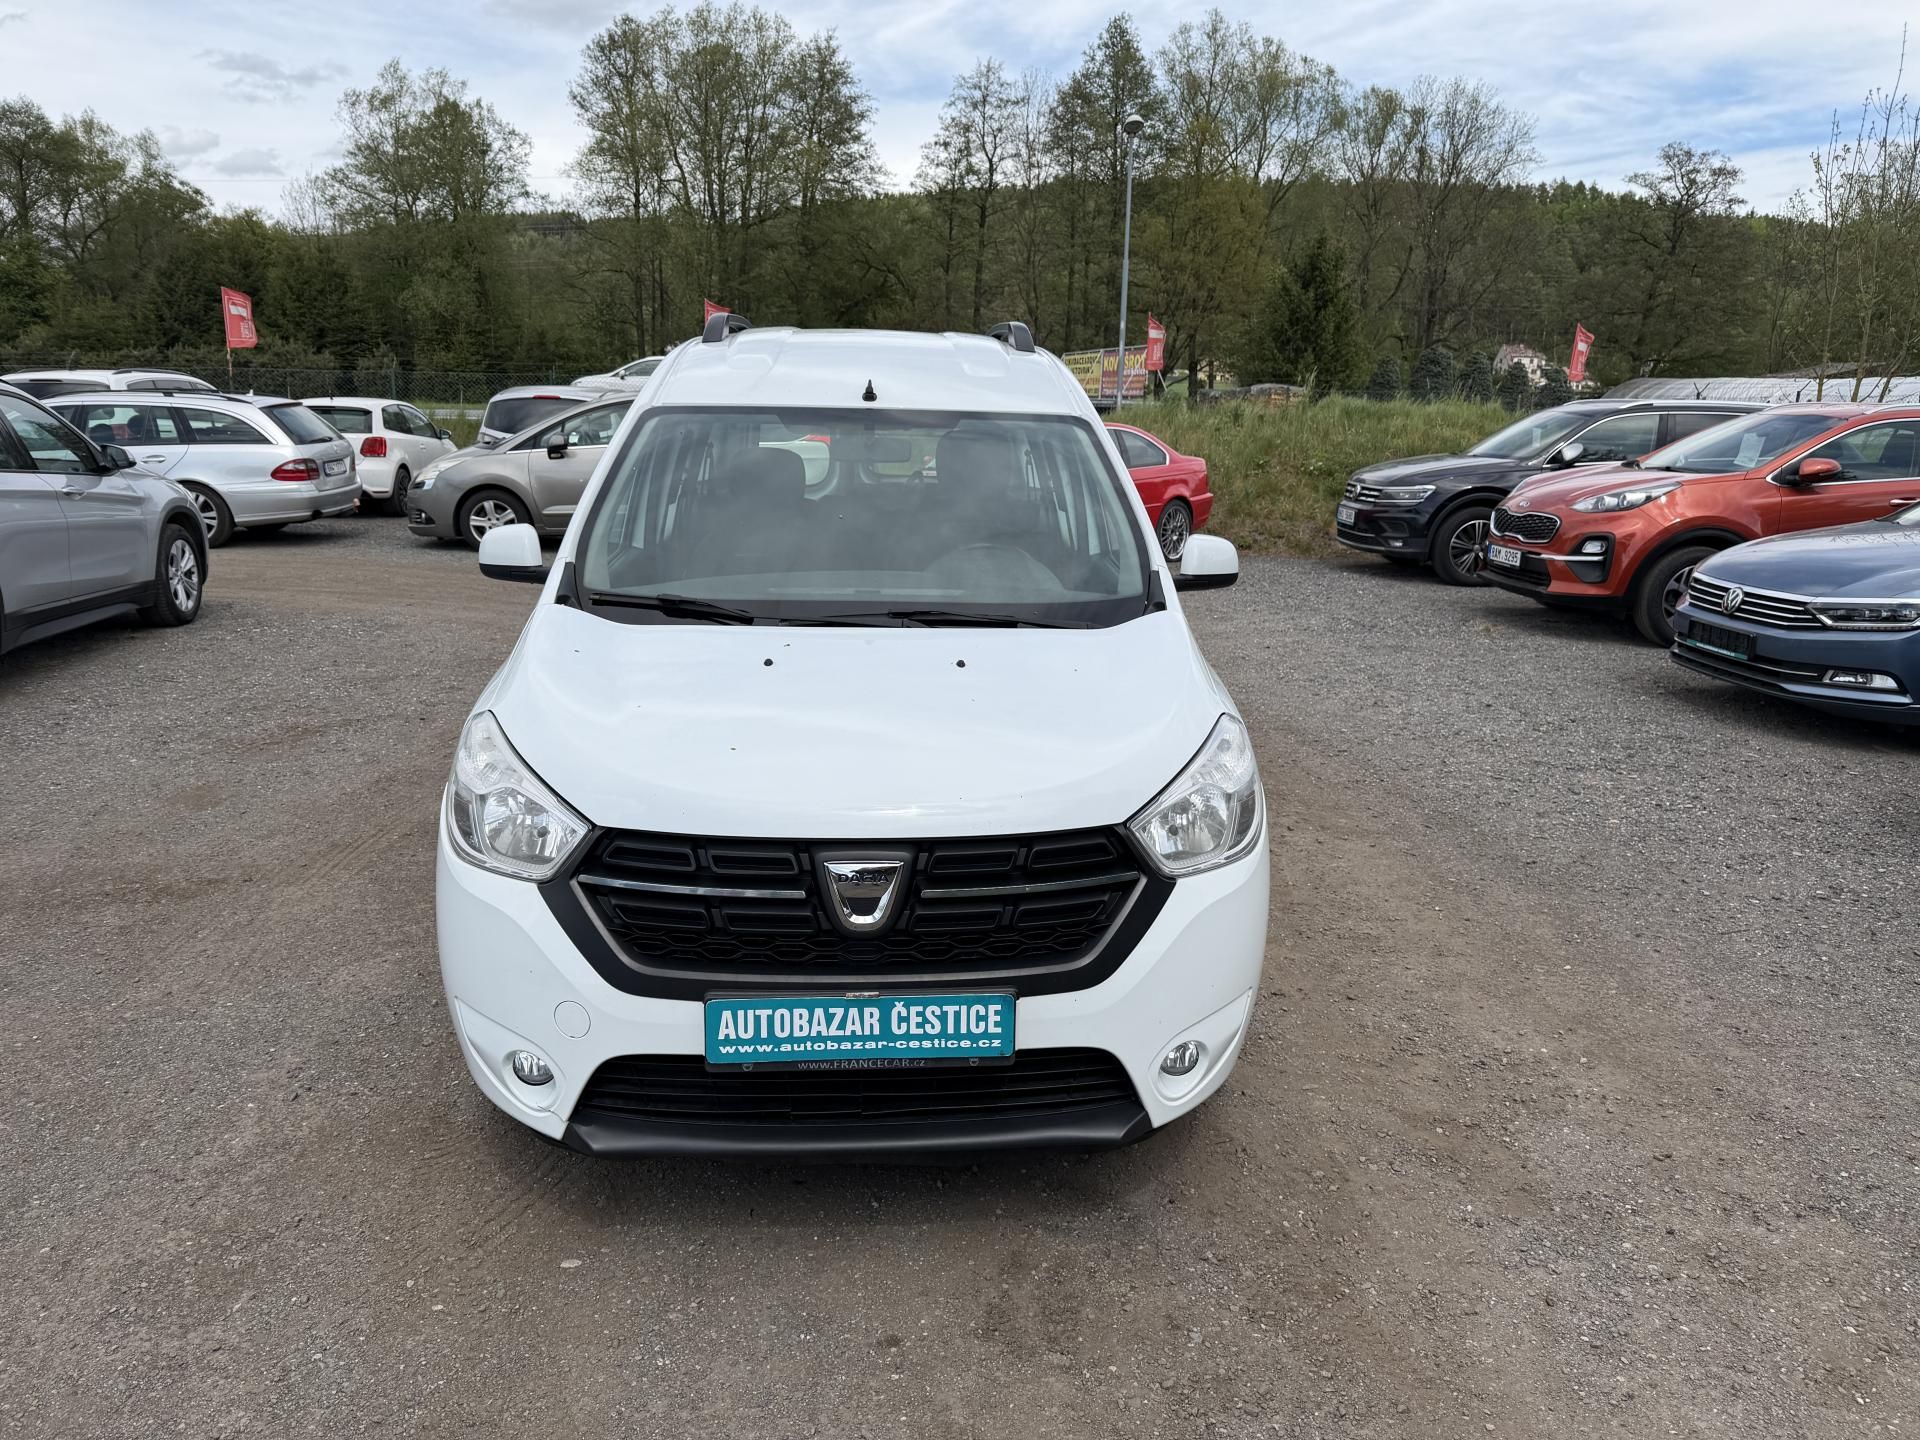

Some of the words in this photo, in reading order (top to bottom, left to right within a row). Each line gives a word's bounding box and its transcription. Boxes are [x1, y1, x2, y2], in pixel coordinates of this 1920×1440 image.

[717, 1007, 880, 1040] AUTOBAZAR
[891, 1001, 1002, 1035] ČESTICE
[718, 1038, 1002, 1054] www.autobazar-cestice.cz
